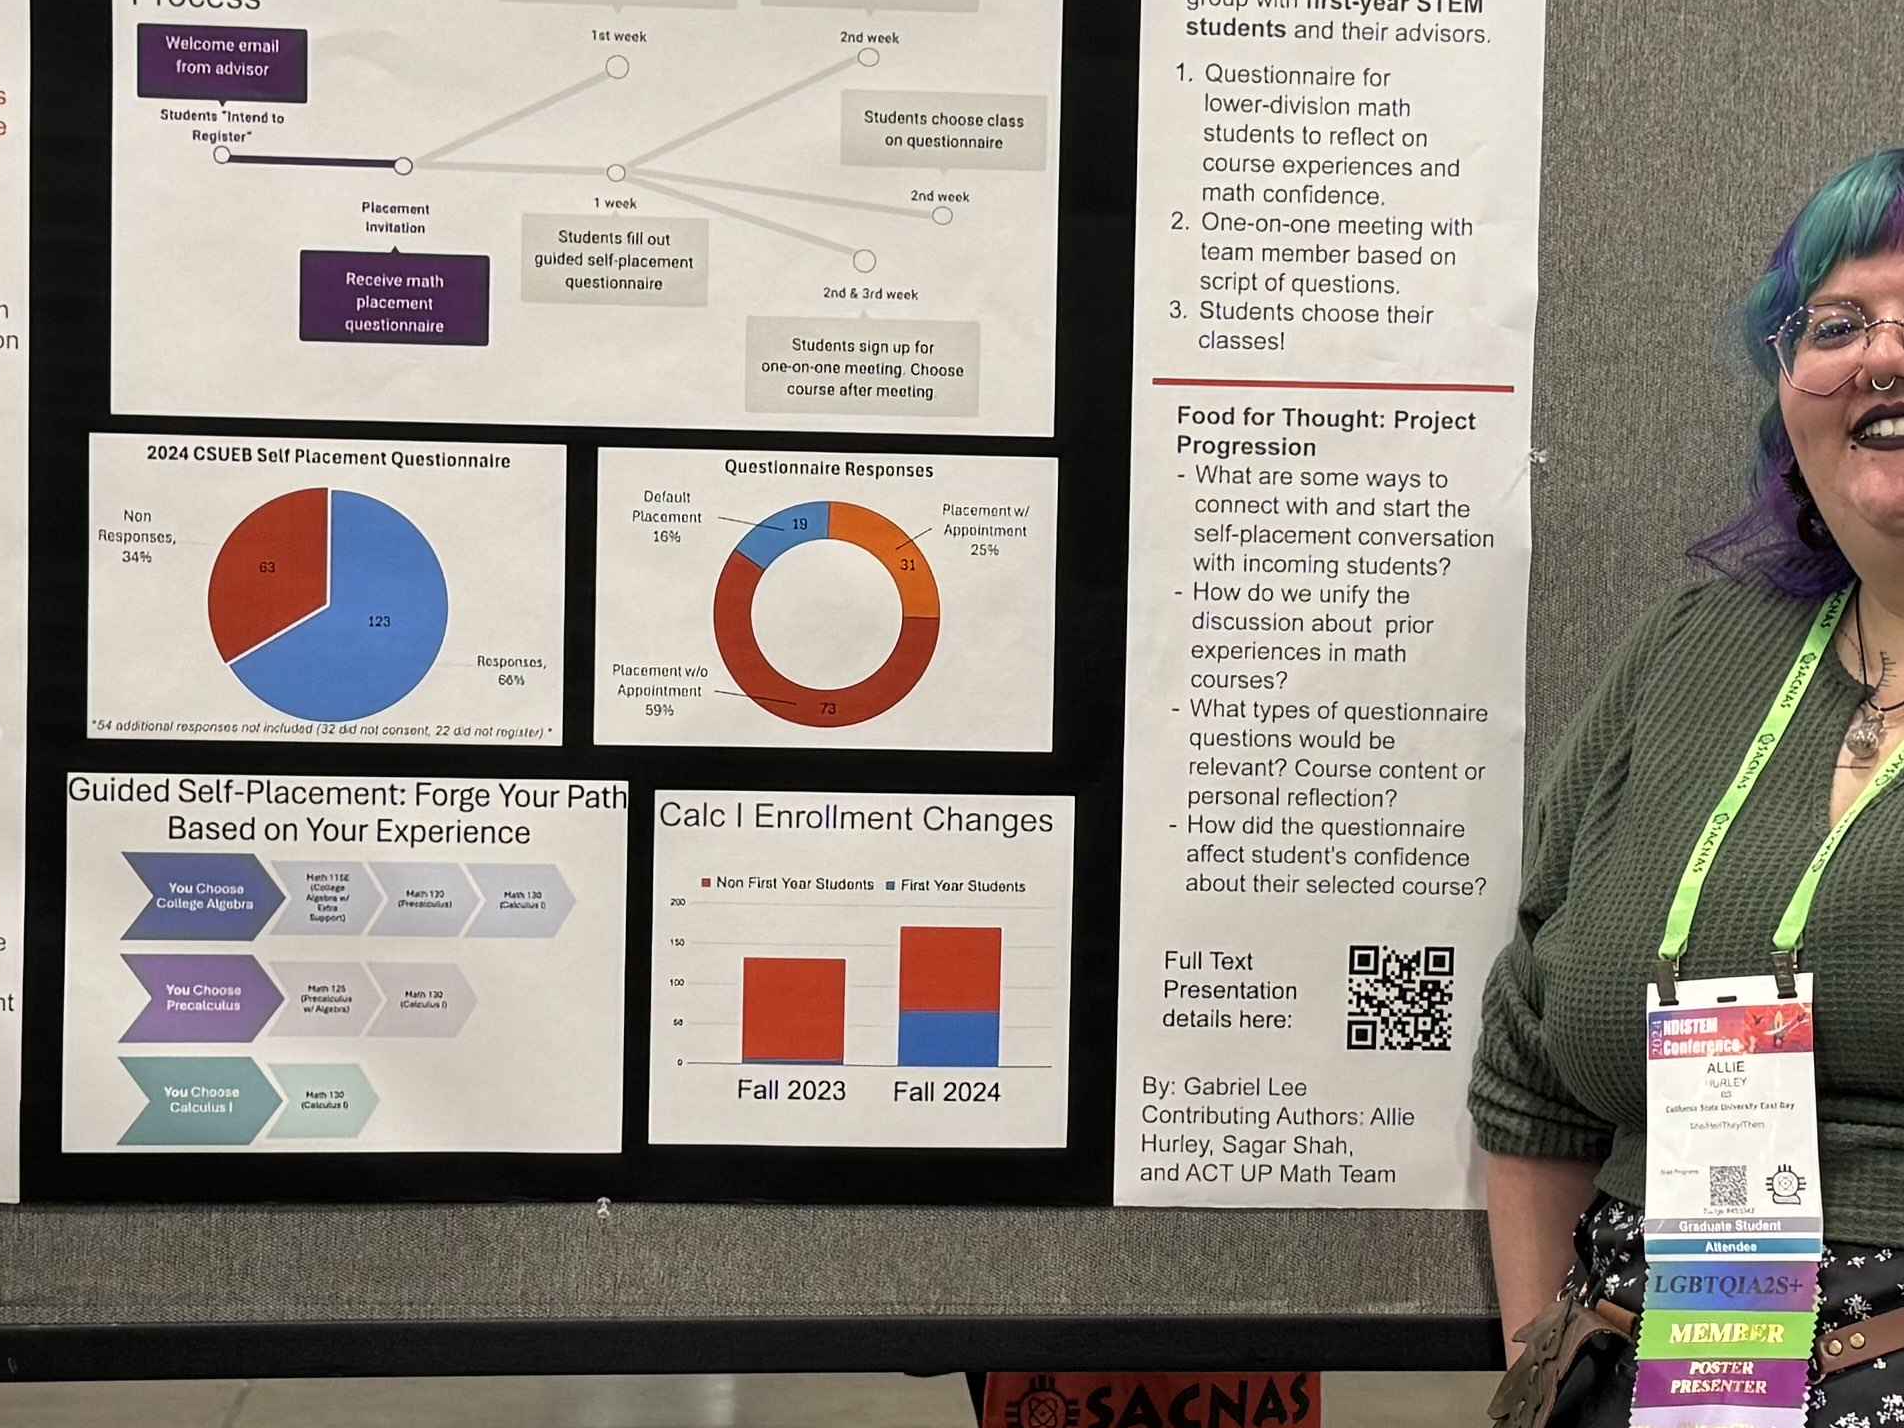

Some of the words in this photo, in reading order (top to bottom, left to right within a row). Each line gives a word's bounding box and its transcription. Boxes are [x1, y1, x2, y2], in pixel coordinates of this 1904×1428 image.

[1186, 18, 1286, 38] students
[1294, 20, 1333, 39] and
[1342, 22, 1388, 41] their
[1396, 23, 1490, 43] advisors.
[166, 36, 234, 52] Welcome
[239, 40, 278, 52] email
[176, 60, 211, 74] from
[216, 61, 269, 76] advisor
[148, 446, 188, 460] 2024
[194, 446, 252, 462] CSUEB
[258, 448, 290, 463] Self
[295, 449, 386, 465] Placement
[392, 452, 510, 468] Questionnaire
[725, 459, 840, 476] Questionnaire
[846, 462, 933, 480] Responses
[1780, 662, 1807, 709] SACNAS
[69, 777, 169, 802] Guided
[179, 779, 405, 806] Self-Placement:
[416, 782, 490, 812] Forge
[499, 784, 560, 808] Your
[568, 785, 626, 808] Path
[660, 802, 725, 827] Calc
[738, 802, 741, 828] I
[756, 803, 912, 830] Enrollment
[924, 806, 1052, 838] Changes
[169, 816, 255, 840] Based
[265, 823, 297, 841] on
[306, 817, 368, 842] Your
[377, 819, 530, 848] Experience
[1693, 825, 1719, 873] SACNAS
[1166, 951, 1202, 970] Full
[1210, 952, 1253, 970] Text
[1165, 980, 1296, 1000] Presentation
[1163, 1008, 1232, 1028] details
[1240, 1010, 1291, 1028] here:
[1663, 1038, 1741, 1057] Conference
[1707, 1061, 1745, 1073] ALLIE
[738, 1079, 778, 1100] Fall
[788, 1080, 846, 1100] 2023
[894, 1082, 934, 1102] Fall
[944, 1082, 1000, 1102] 2024
[1143, 1076, 1175, 1100] By:
[1184, 1077, 1260, 1096] Gabriel
[1269, 1078, 1306, 1096] Lee
[1679, 1221, 1731, 1232] Graduate
[1735, 1220, 1781, 1231] Student
[1705, 1241, 1757, 1253] Attendee
[1655, 1275, 1803, 1298] LGBTQIA2S+
[1669, 1323, 1784, 1343] MEMBER
[1689, 1361, 1754, 1376] POSTER
[1670, 1379, 1767, 1394] PRESENTER
